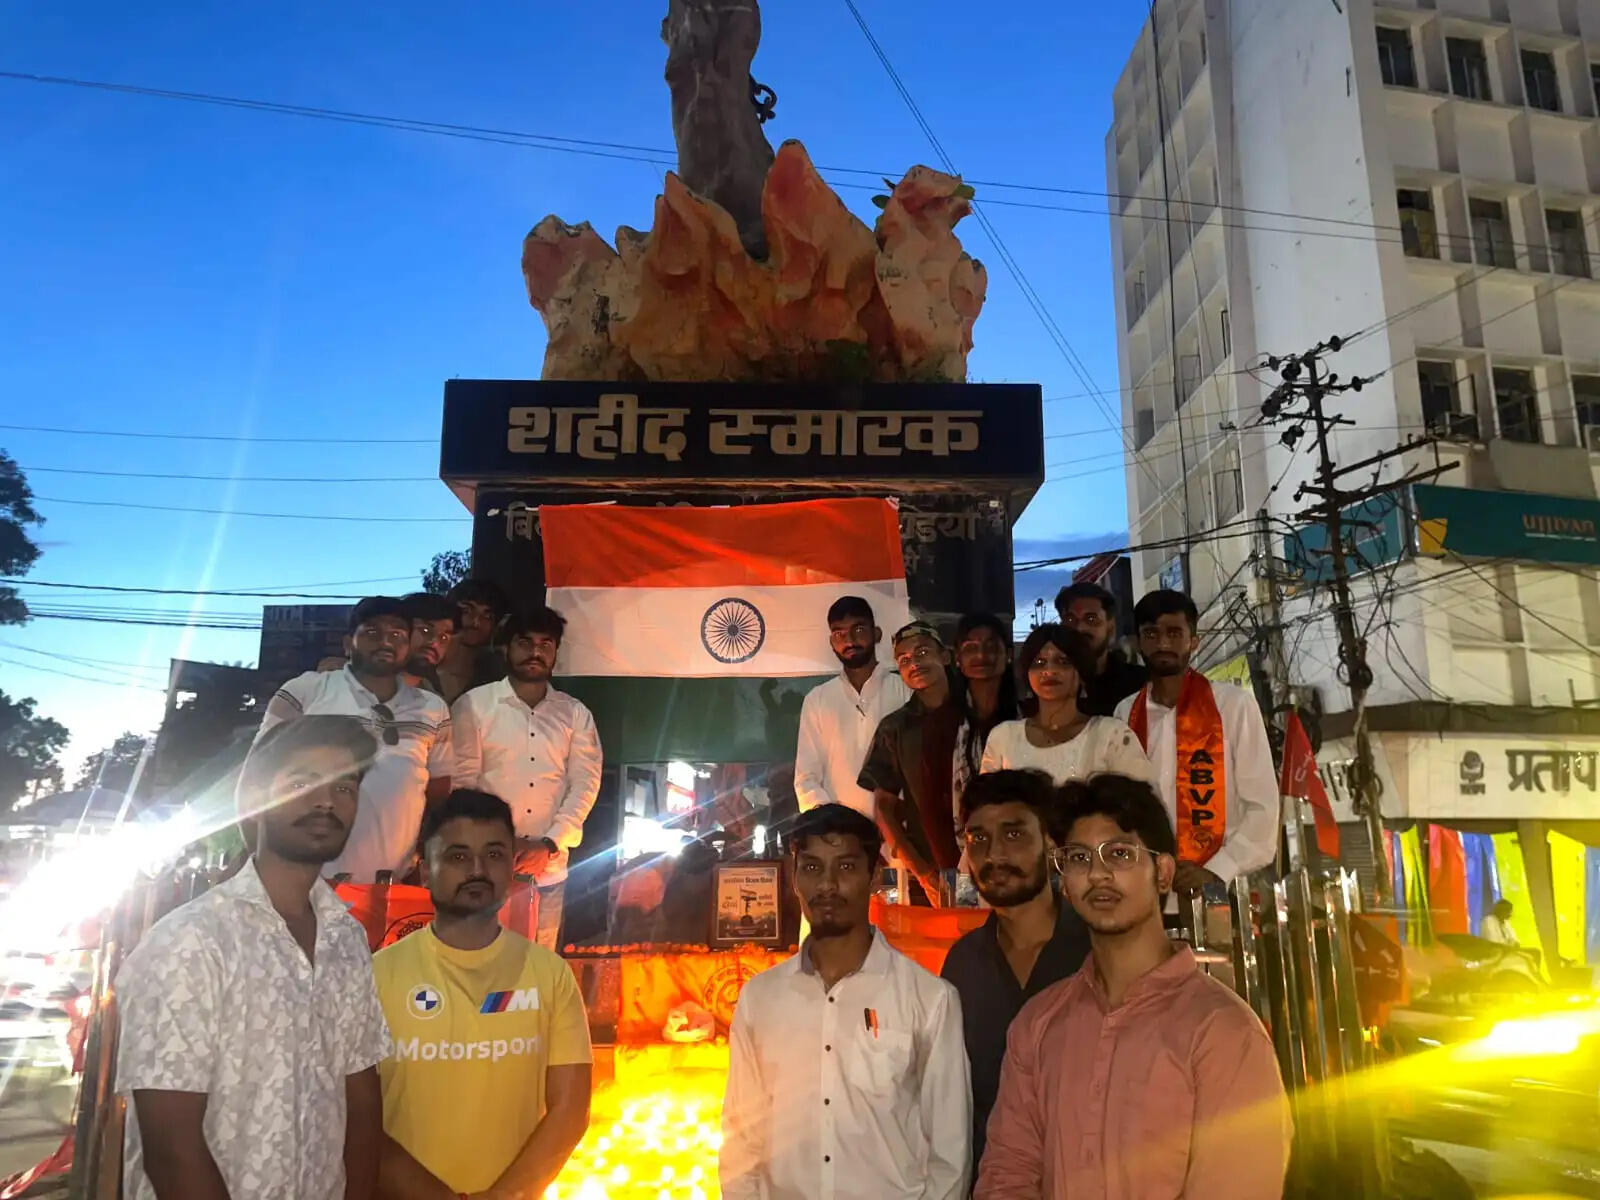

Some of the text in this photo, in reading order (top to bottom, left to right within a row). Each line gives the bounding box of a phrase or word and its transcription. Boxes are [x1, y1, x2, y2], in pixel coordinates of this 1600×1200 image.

[508, 394, 984, 461] शहीद स्मारक
[1189, 749, 1215, 826] ABVP
[1505, 749, 1600, 792] प्रताप
[506, 987, 539, 1011] M
